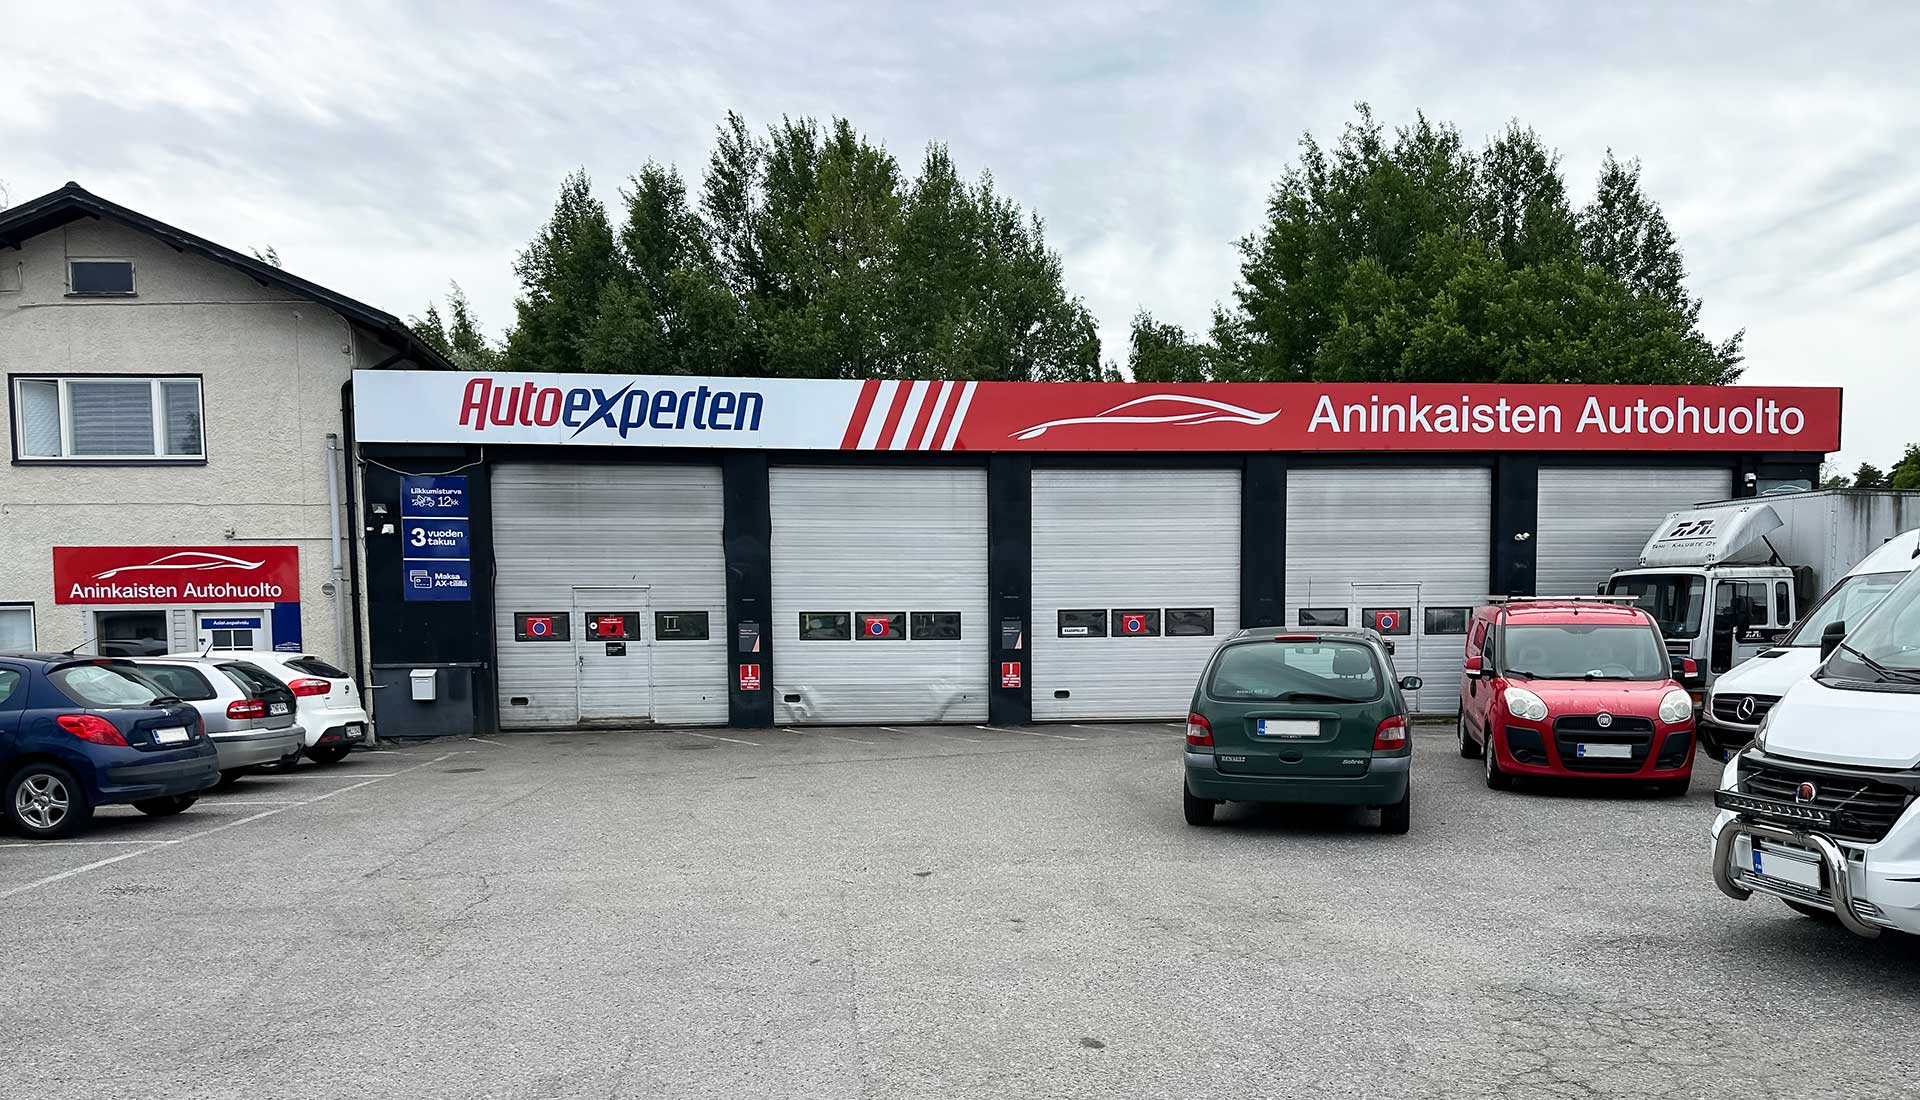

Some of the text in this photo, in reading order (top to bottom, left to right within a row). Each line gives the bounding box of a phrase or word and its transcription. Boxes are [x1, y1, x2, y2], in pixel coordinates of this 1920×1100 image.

[458, 378, 764, 440] Autoexperten
[1307, 395, 1806, 436] Aninkaisten Autohuolto
[410, 487, 462, 495] Liikkumisturva
[410, 527, 464, 547] 3 vuoden
[427, 538, 456, 546] takuu
[69, 581, 283, 599] Aninkaisten Autohuolto
